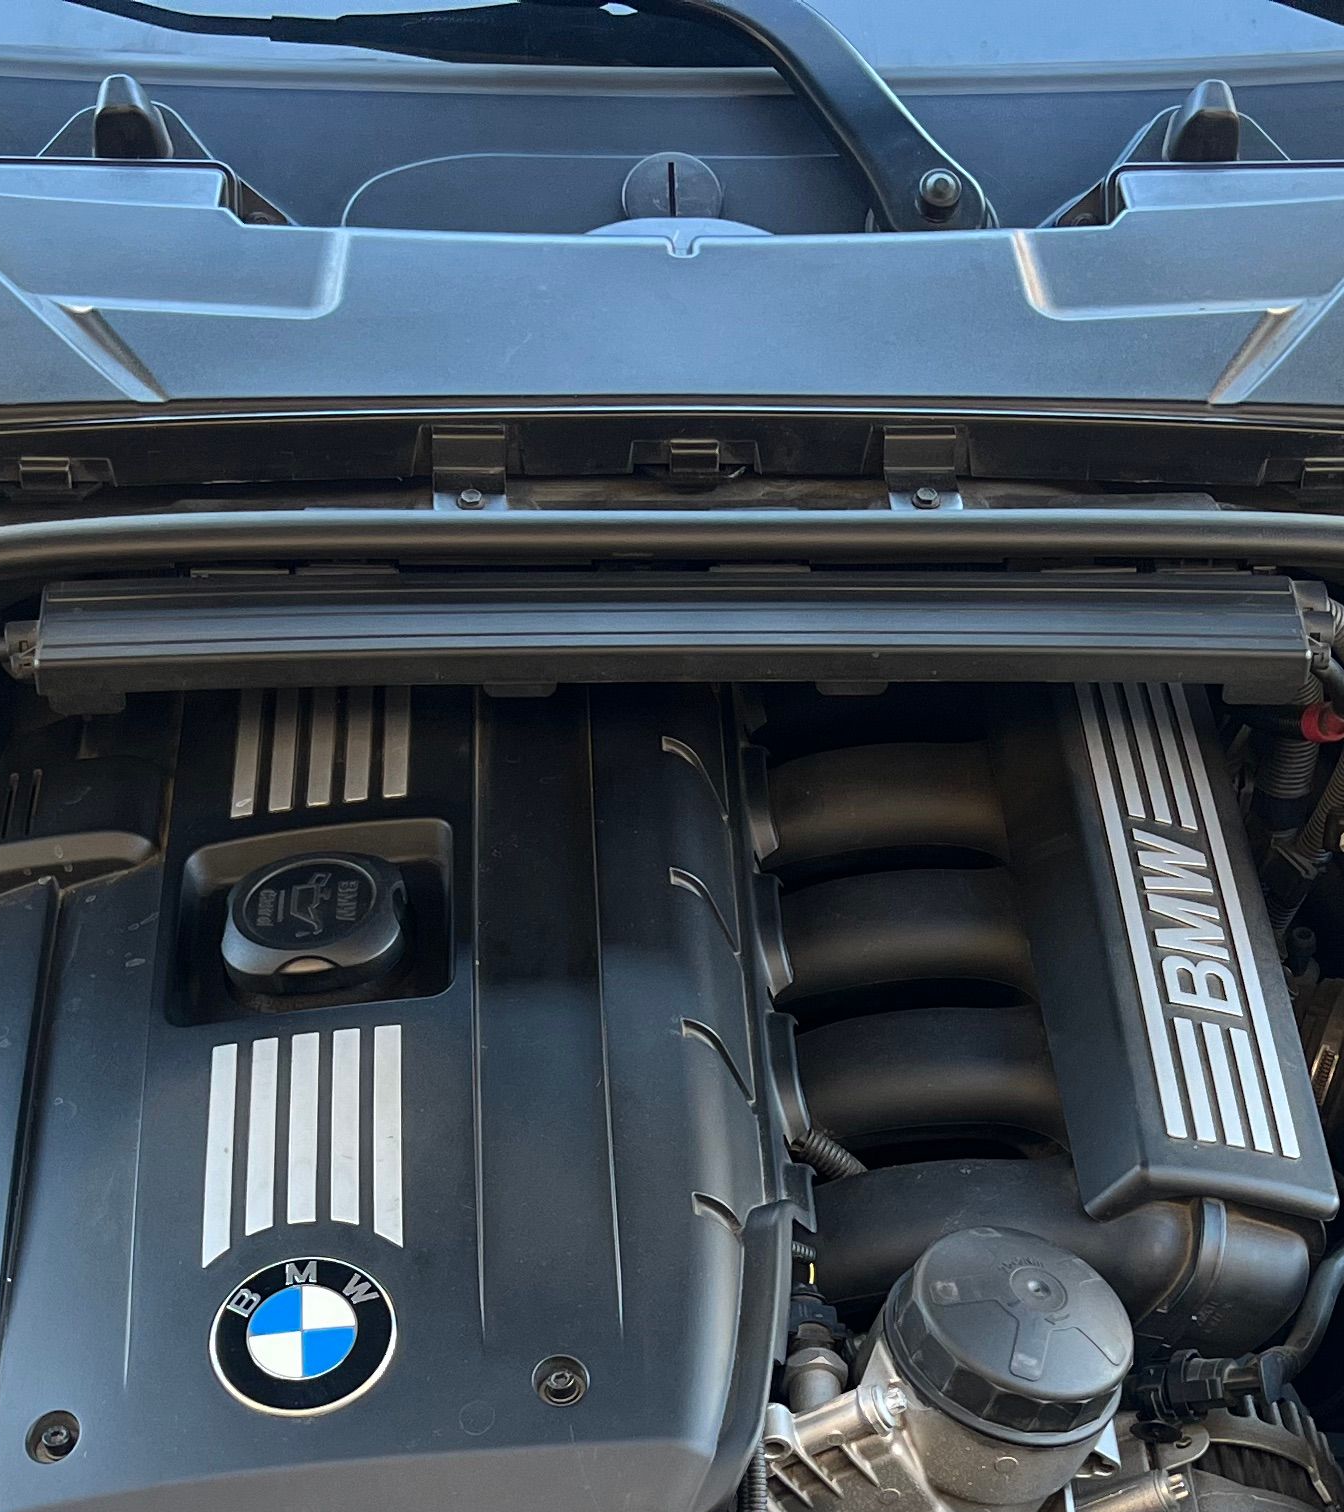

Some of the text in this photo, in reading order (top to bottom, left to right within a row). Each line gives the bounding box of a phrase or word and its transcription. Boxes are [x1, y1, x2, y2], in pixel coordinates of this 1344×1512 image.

[335, 879, 359, 921] BMW
[1132, 827, 1243, 1017] BMW
[226, 1260, 380, 1318] BMW
